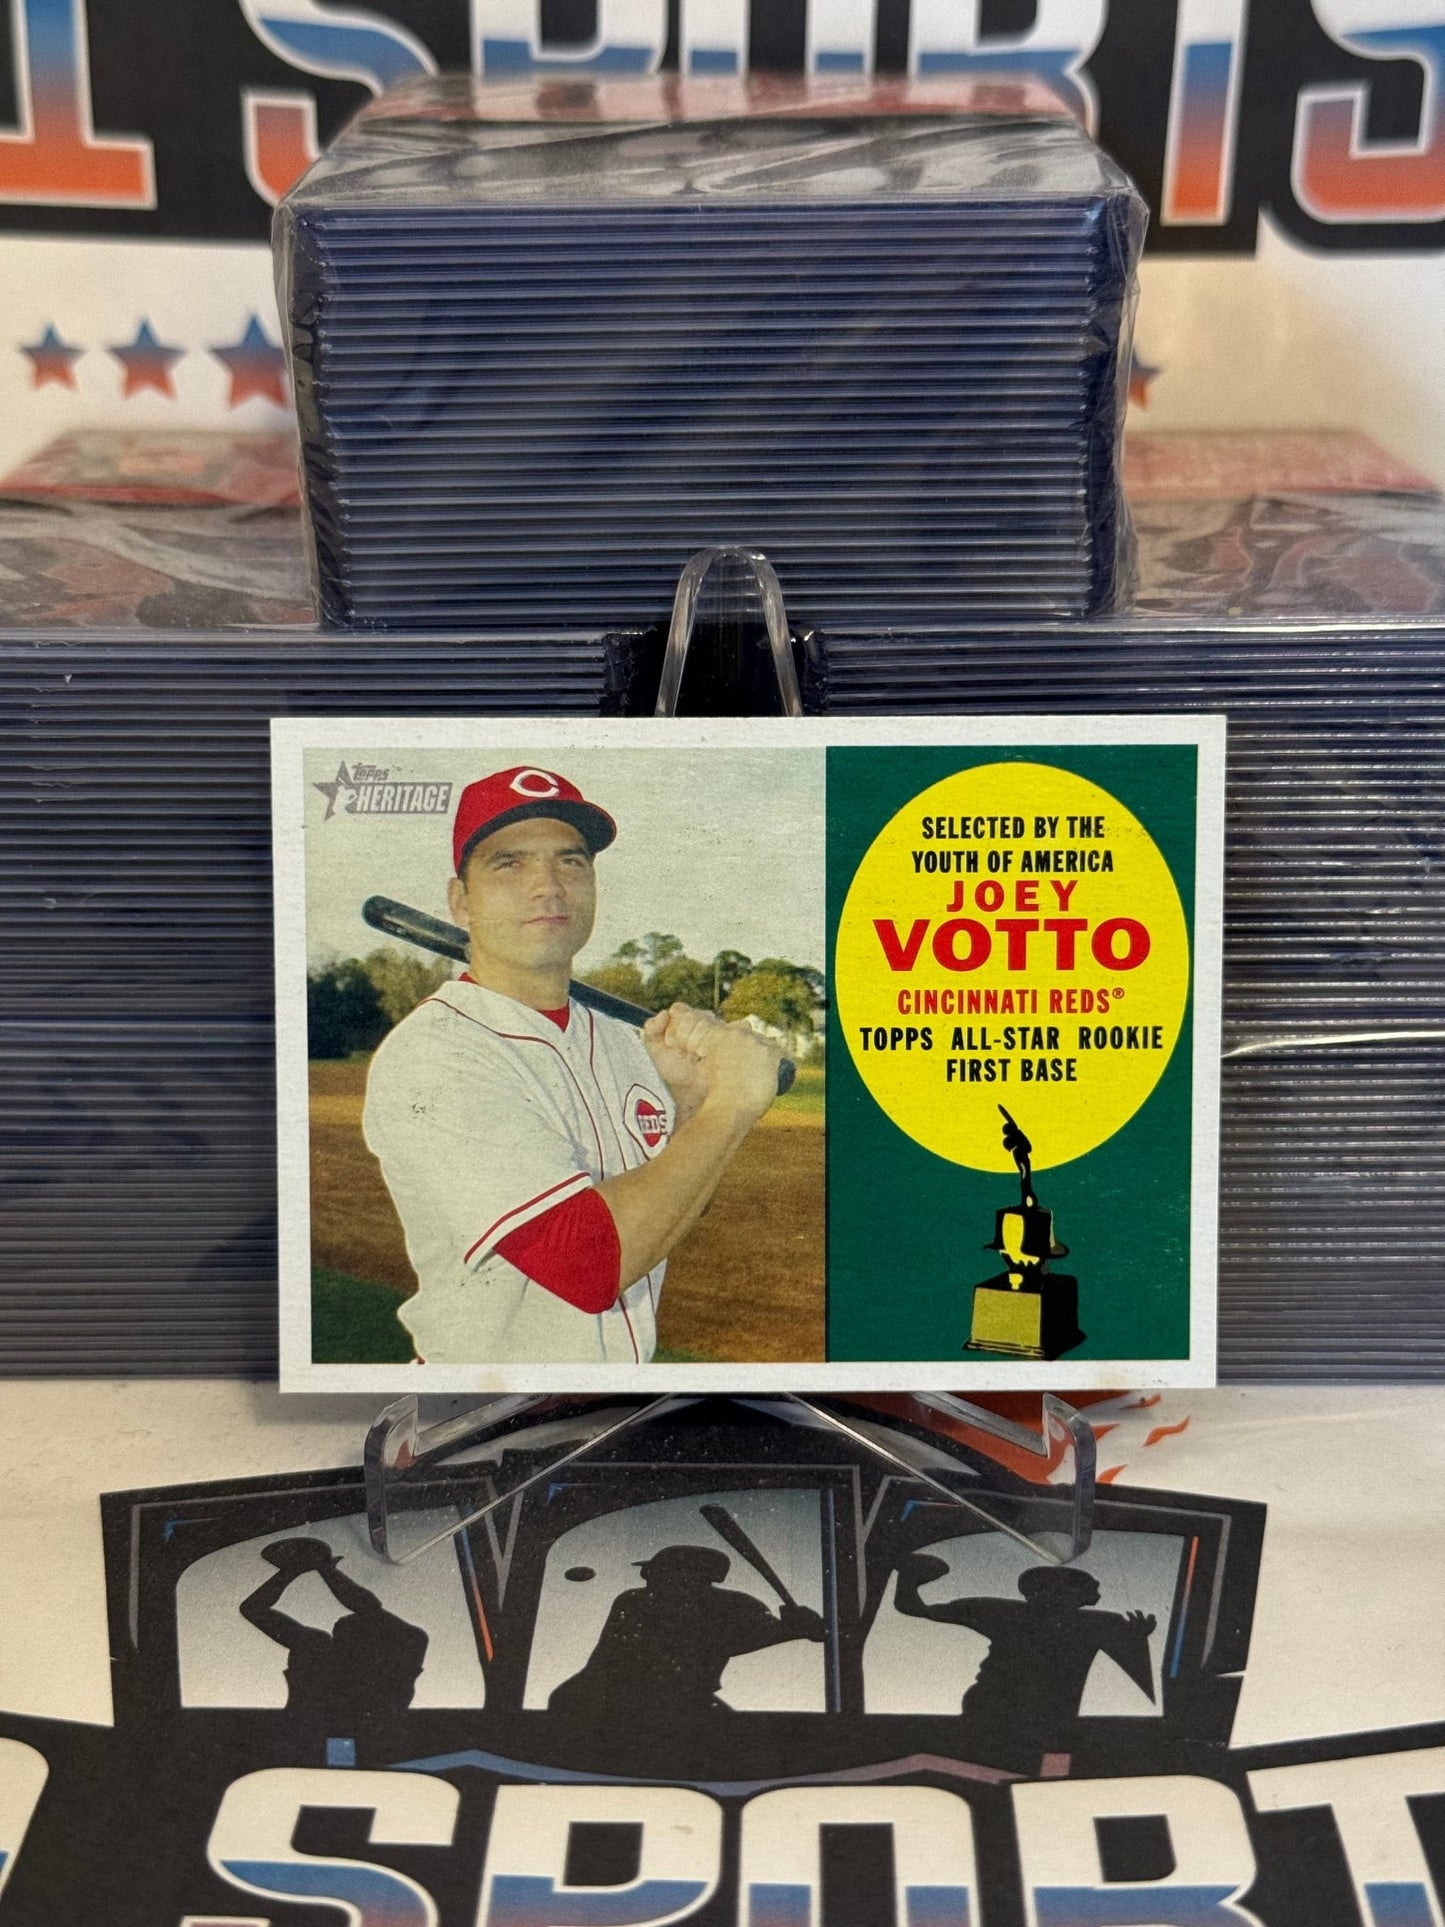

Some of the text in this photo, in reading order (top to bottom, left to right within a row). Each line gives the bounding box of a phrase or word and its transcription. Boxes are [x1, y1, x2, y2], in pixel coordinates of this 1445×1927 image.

[356, 784, 450, 812] HERITAGE
[921, 815, 1106, 840] SELECTED BY THE
[911, 850, 1114, 873] YOUTH OF AMERICA
[945, 879, 1079, 913] JOEY
[873, 917, 1151, 971] VOTTO
[897, 989, 1038, 1015] CINCINNATI
[859, 1025, 1164, 1051] TOPPS ALL-STAR ROOKIE
[946, 1058, 1078, 1082] FIRST BASE
